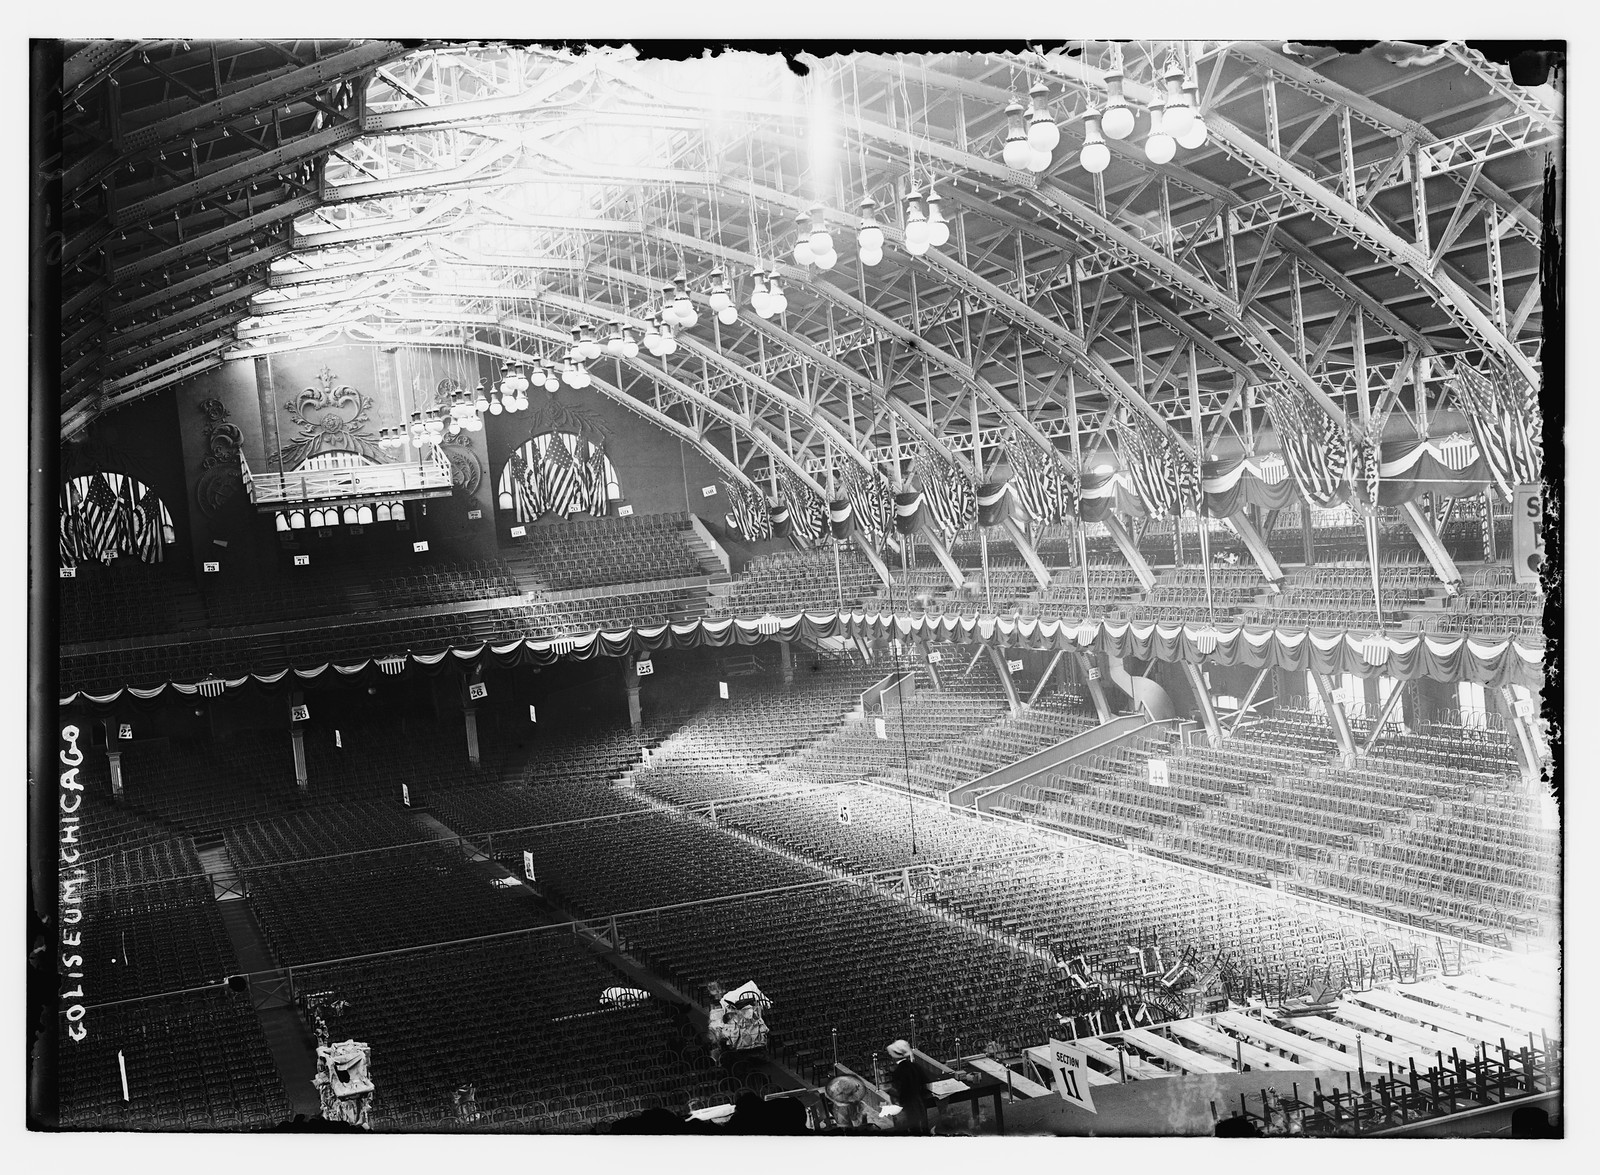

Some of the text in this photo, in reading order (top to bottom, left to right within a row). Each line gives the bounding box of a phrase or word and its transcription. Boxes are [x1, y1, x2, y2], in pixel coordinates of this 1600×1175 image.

[638, 665, 651, 674] 25
[471, 688, 483, 698] 26
[293, 710, 306, 720] 26
[1056, 1051, 1080, 1069] SECTION
[1059, 1067, 1084, 1102] 11
